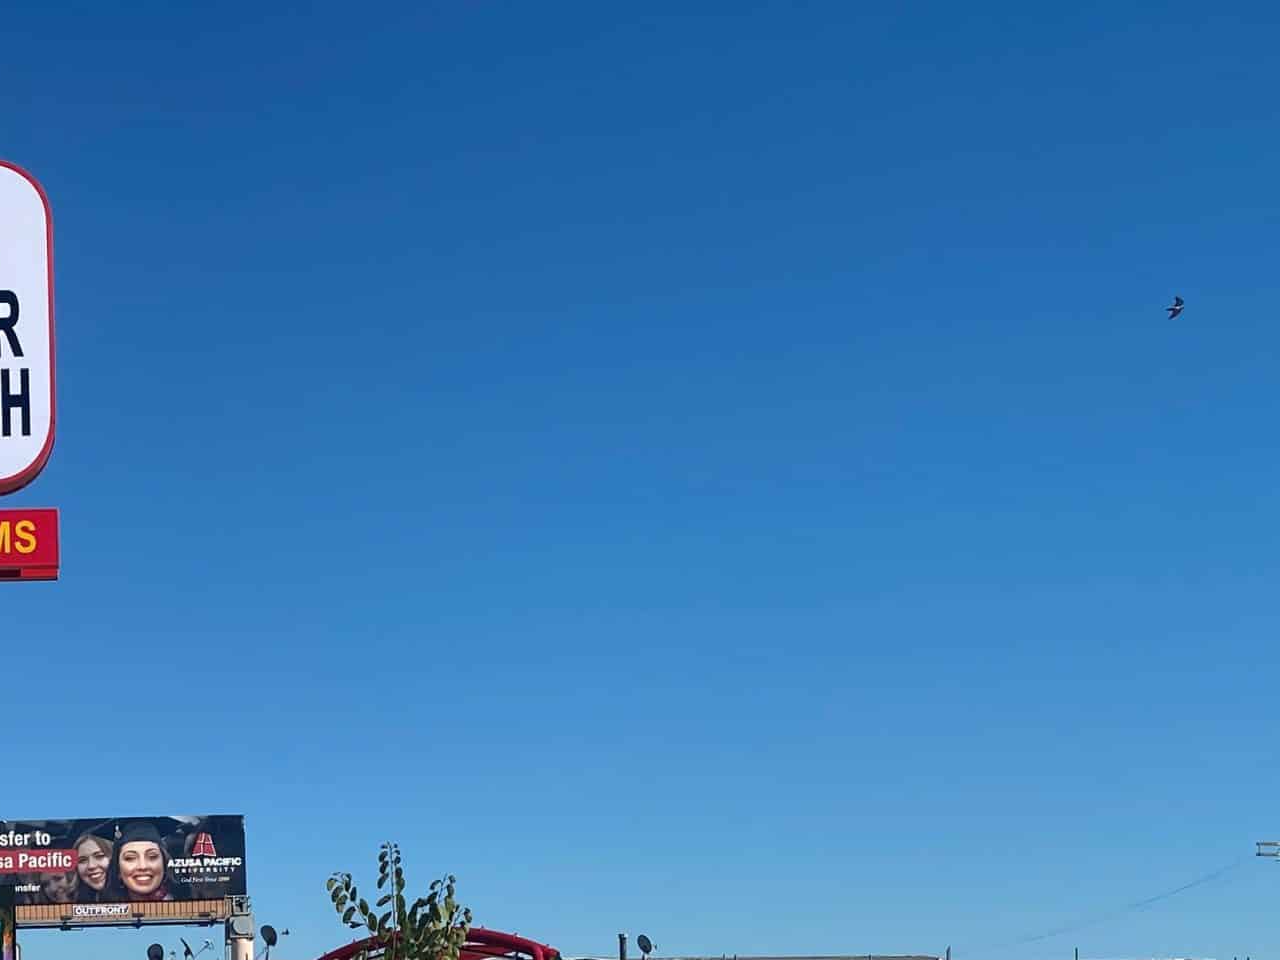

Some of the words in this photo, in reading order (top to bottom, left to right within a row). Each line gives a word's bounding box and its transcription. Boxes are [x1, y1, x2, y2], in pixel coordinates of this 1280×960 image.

[35, 830, 51, 846] to
[18, 852, 72, 868] Pacific
[167, 858, 202, 868] AZUSA
[204, 857, 242, 866] PACIFIC
[174, 866, 236, 874] UNIVERSITY
[76, 905, 128, 914] OUTFRONT
